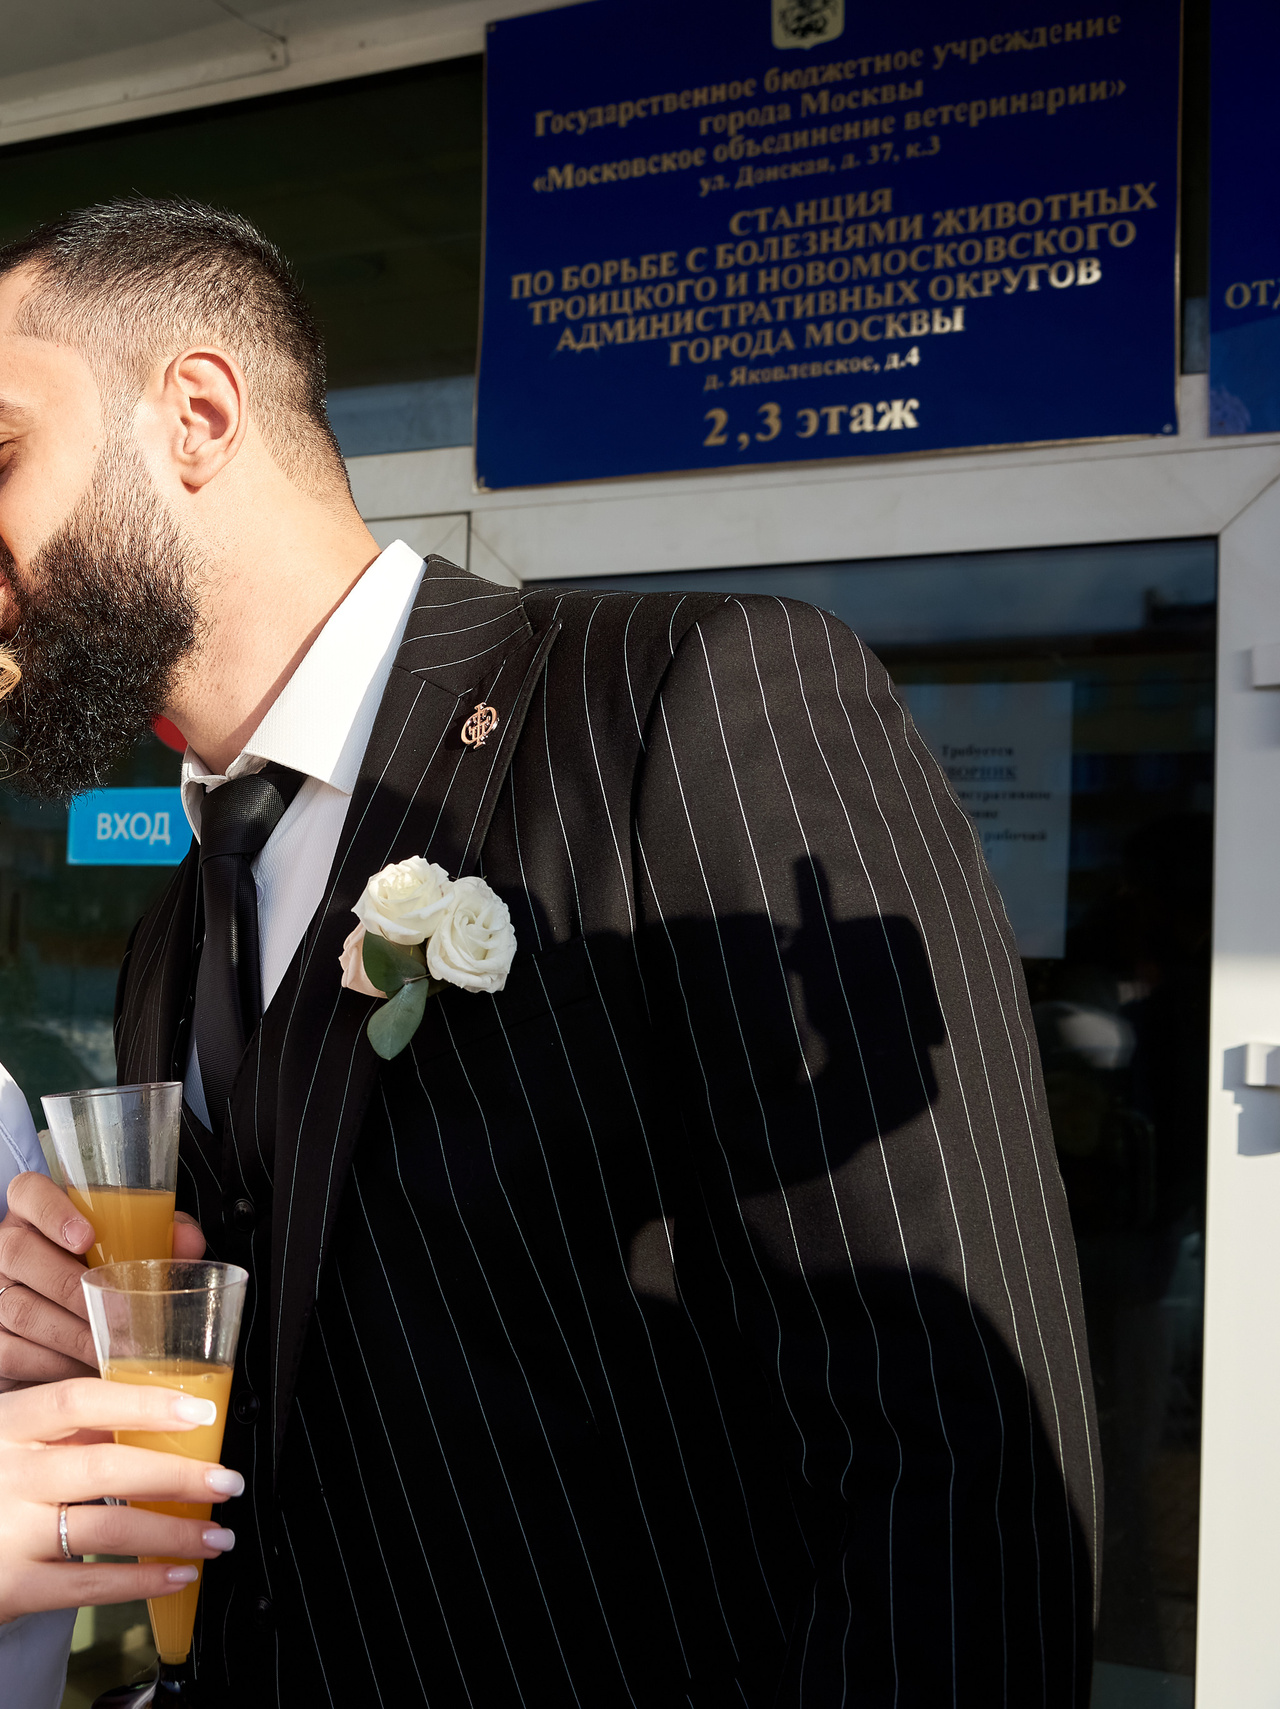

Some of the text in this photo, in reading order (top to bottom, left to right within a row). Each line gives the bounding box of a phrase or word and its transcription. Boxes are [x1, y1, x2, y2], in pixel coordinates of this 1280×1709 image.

[534, 14, 1122, 137] Государственное бюджетное учреждение
[532, 79, 1127, 192] «Московское объединение ветеринарии»
[699, 79, 925, 137] города Москвы
[699, 174, 731, 197] ул.
[734, 156, 837, 191] Донская,
[866, 141, 901, 165] 37,
[905, 135, 942, 160] к.3
[510, 181, 1158, 300] ПО БОРЬБЕ С БОЛЕЗНЯМИ ЖИВОТНЫХ
[728, 186, 894, 237] СТАНЦИЯ
[528, 219, 1137, 326] ТРОИЦКОГО И НОВОМОСКОВСКОГО
[555, 279, 920, 353] АДМИНИСТРАТИВНЫХ
[669, 305, 967, 367] ГОРОДА МОСКВЫ
[703, 345, 921, 393] д. Яковлевское, д.4
[795, 398, 921, 438] этаж
[947, 766, 1017, 778] ВОРНИК
[96, 812, 171, 845] ВХОД
